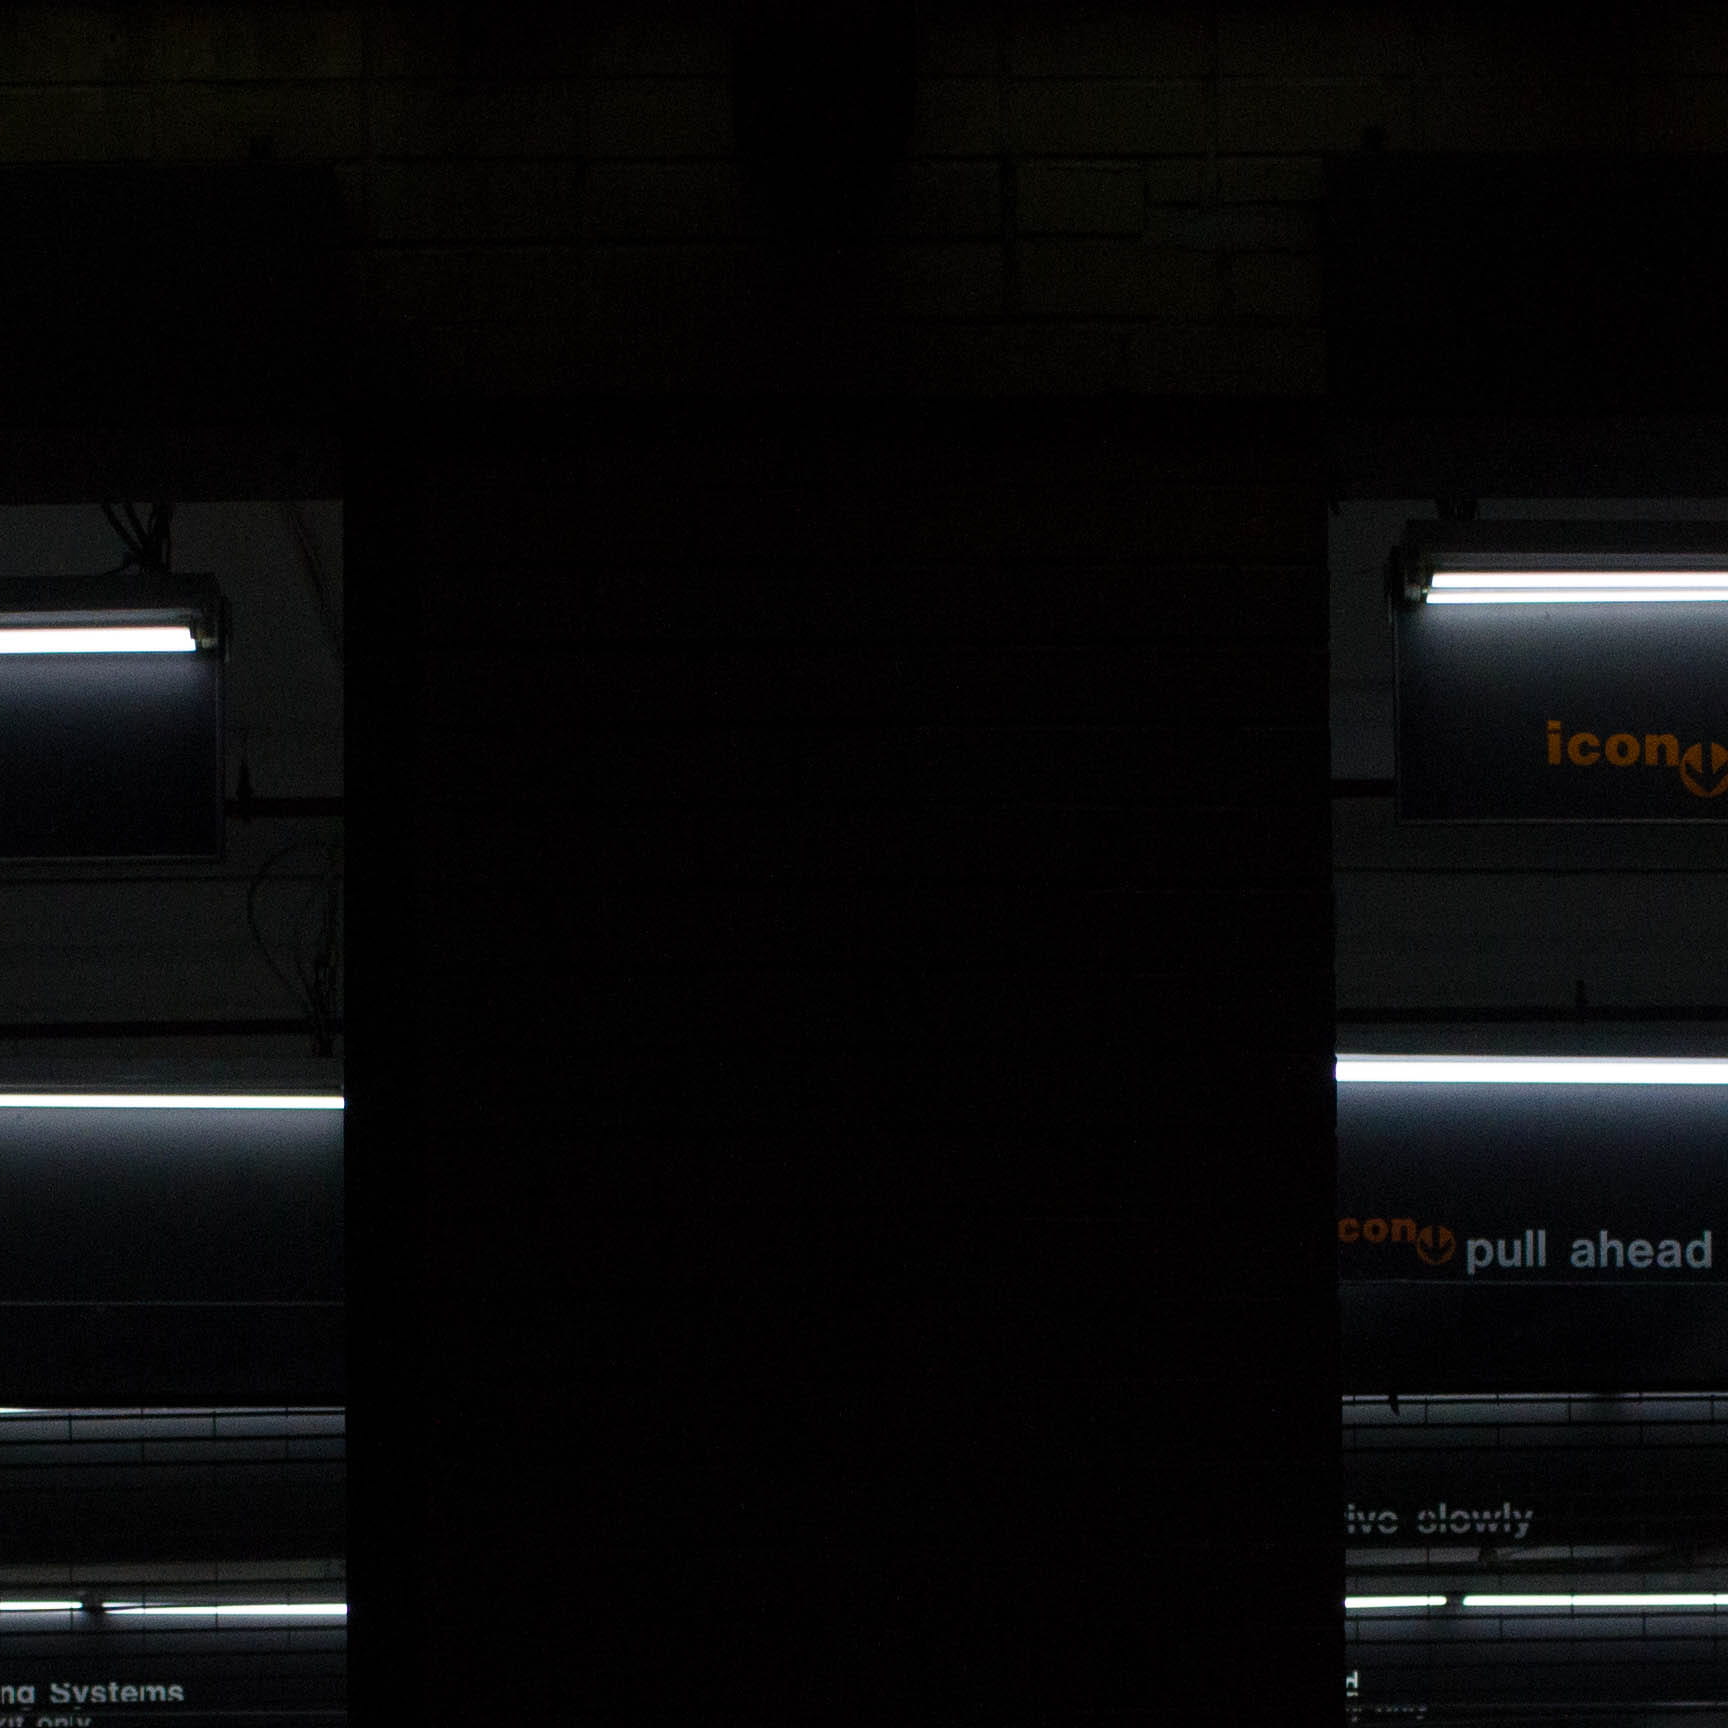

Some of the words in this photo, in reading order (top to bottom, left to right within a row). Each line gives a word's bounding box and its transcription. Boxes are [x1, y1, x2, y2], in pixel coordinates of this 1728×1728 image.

[1546, 719, 1680, 768] icon
[1336, 1216, 1417, 1245] con
[1466, 1228, 1548, 1275] pull
[1570, 1228, 1713, 1270] ahead
[1343, 1502, 1400, 1535] ive
[1416, 1500, 1535, 1540] slowly
[48, 1680, 186, 1711] Systems
